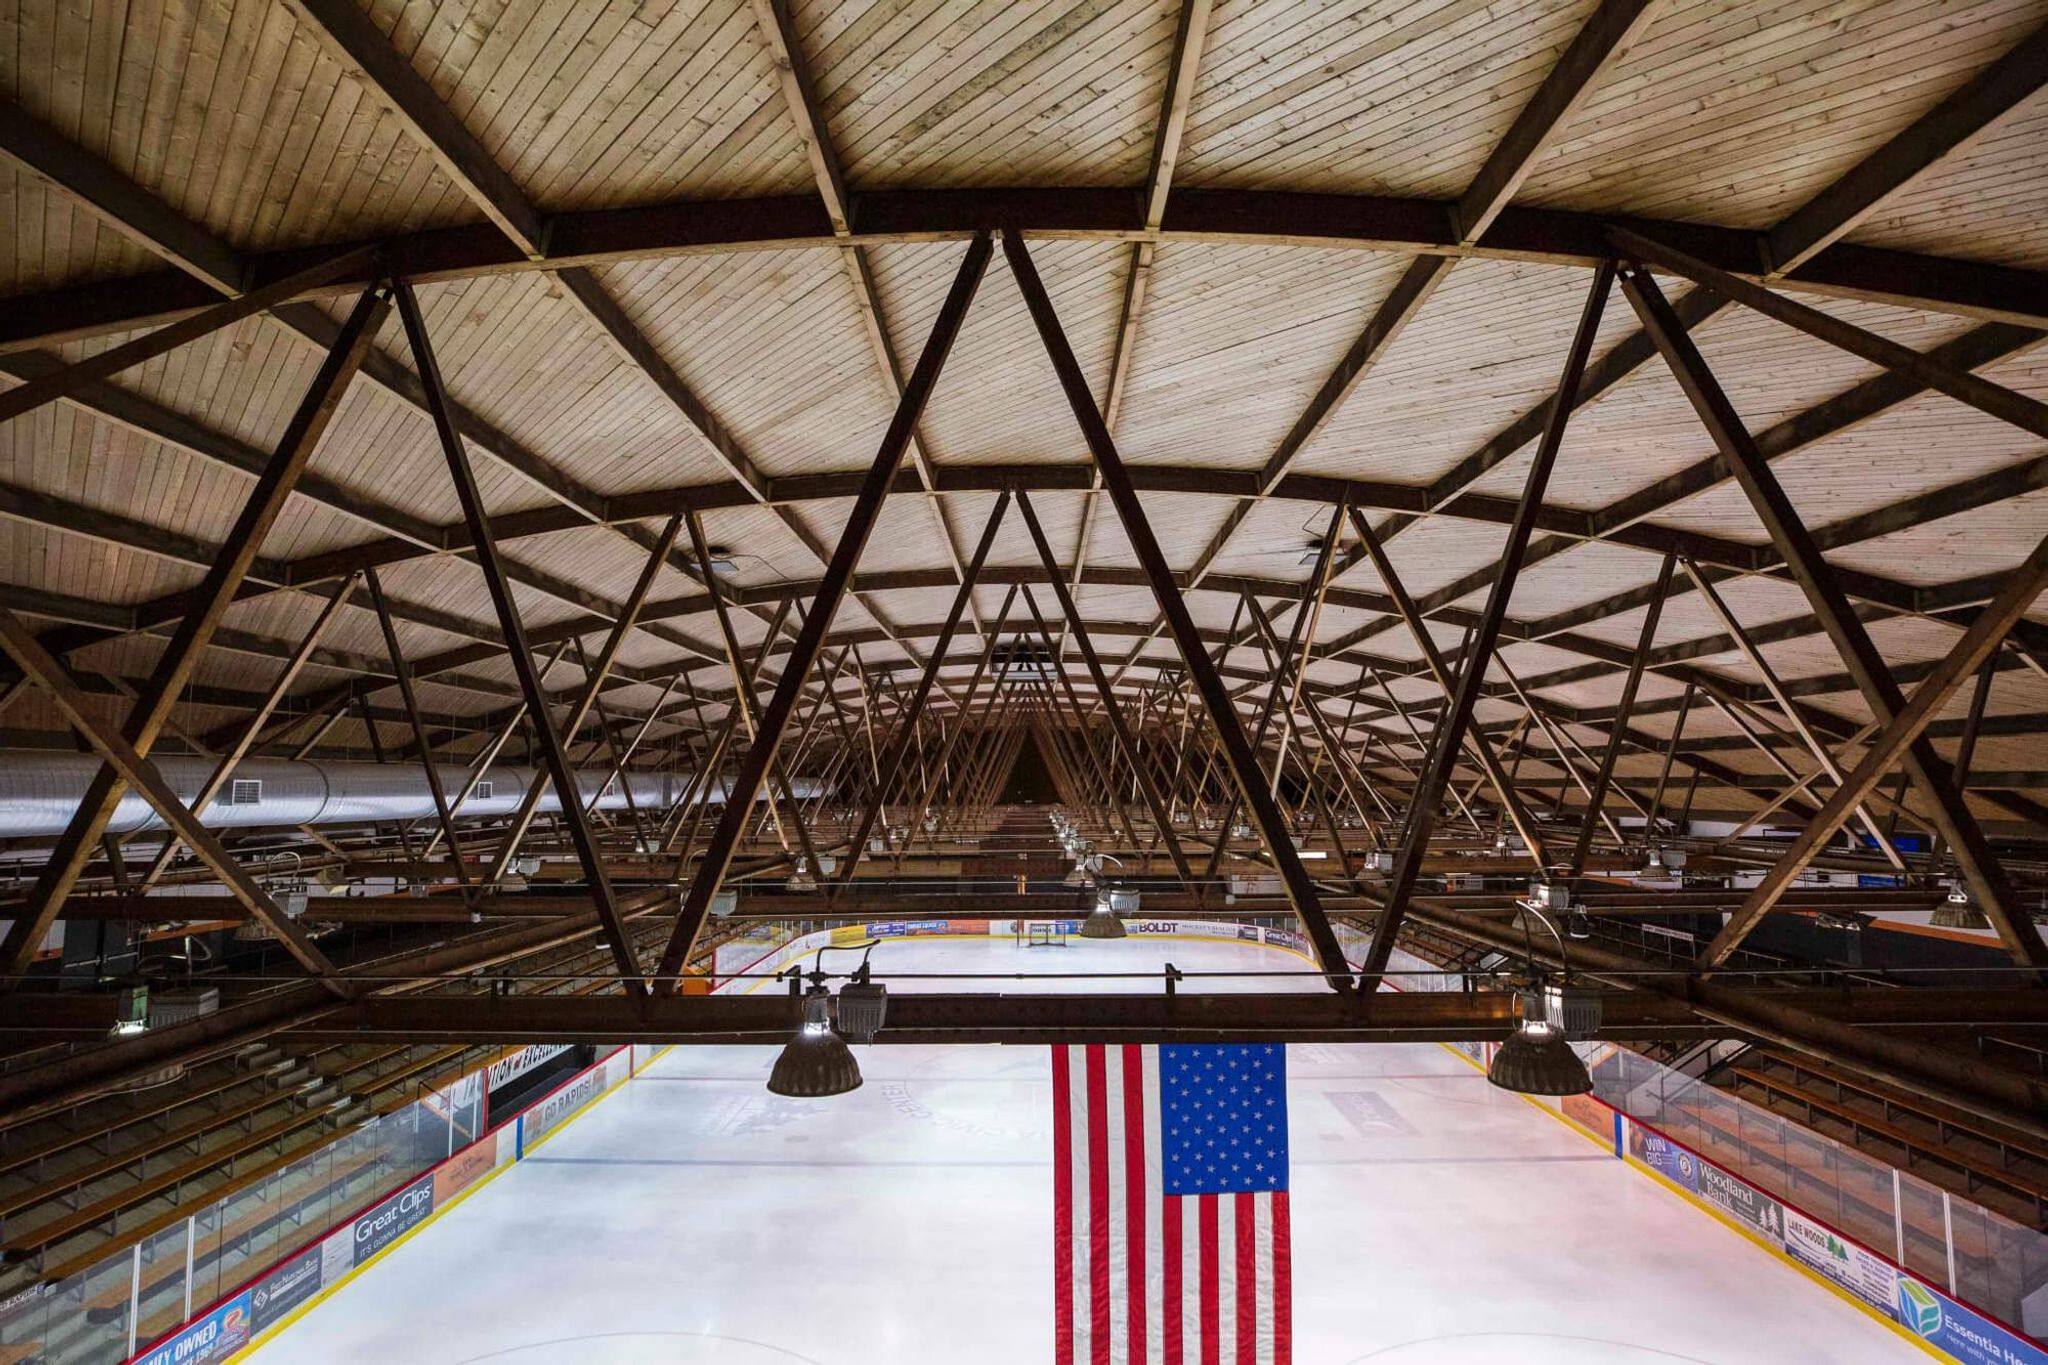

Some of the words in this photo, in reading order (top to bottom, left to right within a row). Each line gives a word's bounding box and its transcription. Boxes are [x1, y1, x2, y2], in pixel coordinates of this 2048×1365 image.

[1138, 922, 1178, 933] BOLDT
[544, 1101, 557, 1121] GO
[1645, 1137, 1666, 1152] WIN
[1646, 1151, 1663, 1166] BIG
[1699, 1162, 1753, 1206] Woodland
[1706, 1181, 1733, 1209] Bank
[355, 1205, 398, 1243] Great
[399, 1185, 432, 1214] Clips
[373, 1229, 396, 1250] GONNA
[1787, 1217, 1803, 1237] LAKE
[1804, 1225, 1826, 1248] WOODS
[175, 1321, 218, 1361] OWNED
[1944, 1315, 2001, 1358] Essentia
